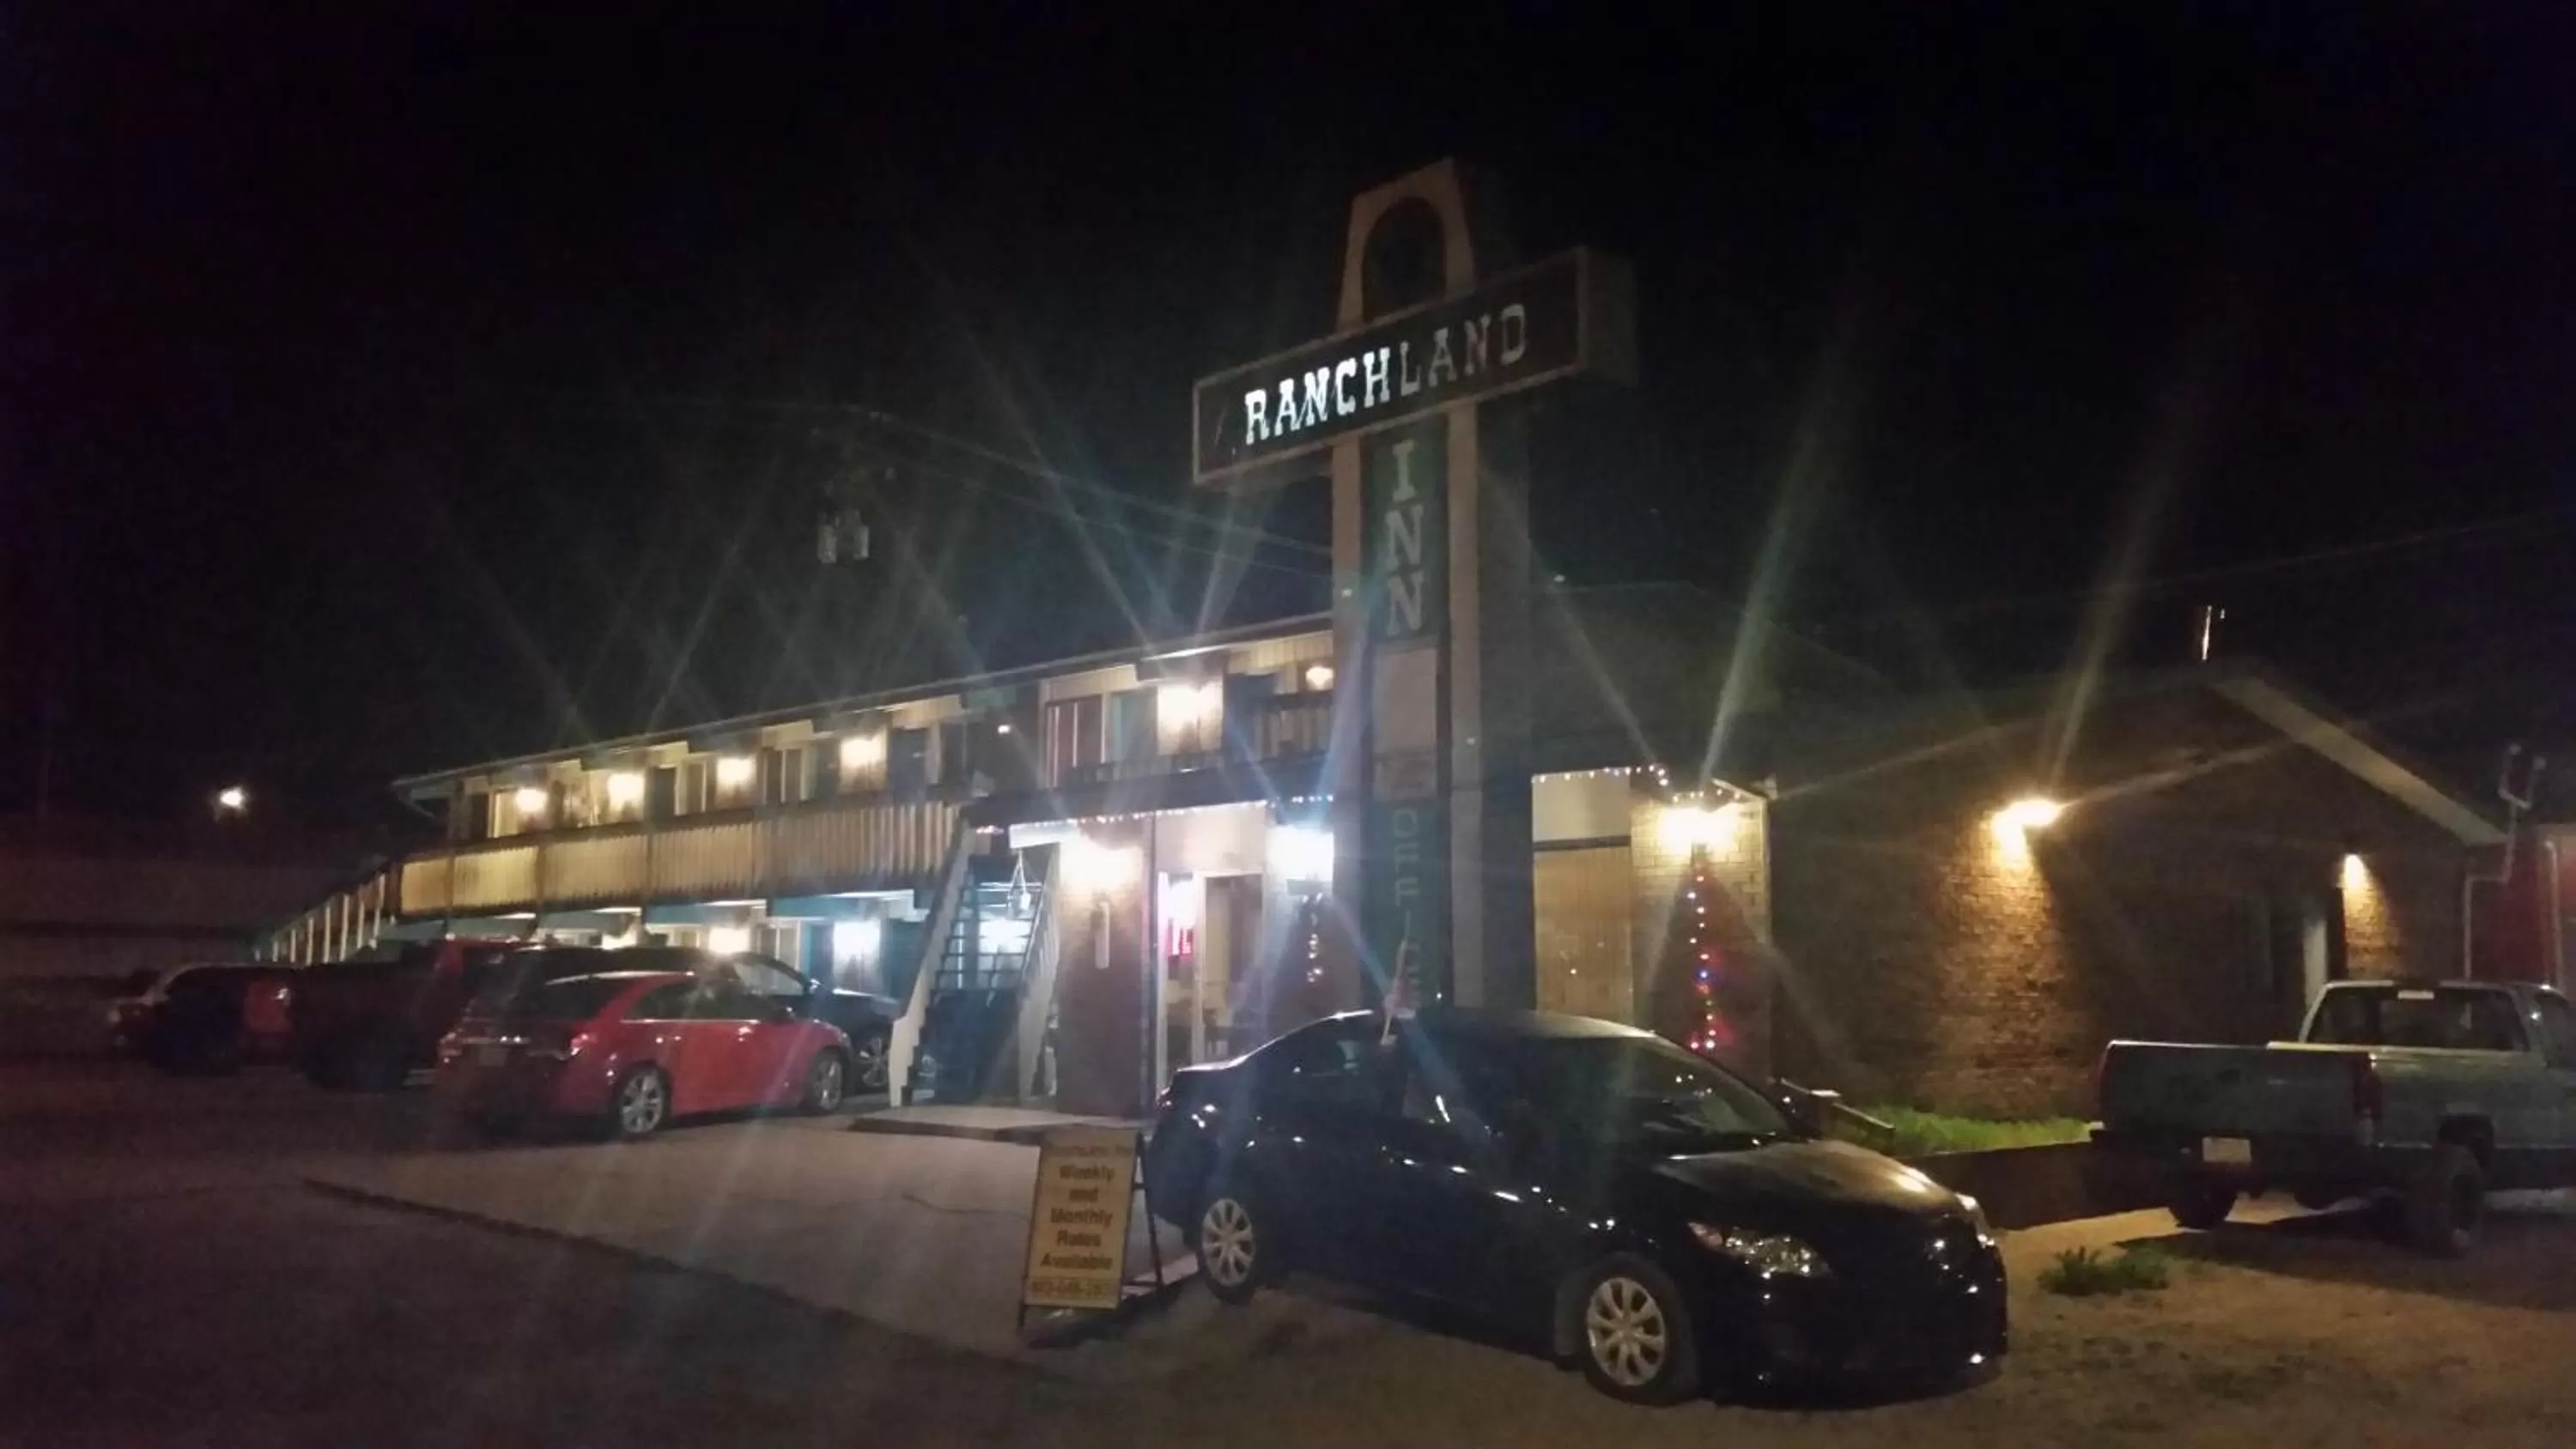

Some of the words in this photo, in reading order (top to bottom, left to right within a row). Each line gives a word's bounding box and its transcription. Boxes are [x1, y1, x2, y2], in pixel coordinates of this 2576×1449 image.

[1245, 303, 1527, 446] RANCHLAND
[1385, 439, 1424, 635] INN
[1049, 1208, 1114, 1228] Monthly
